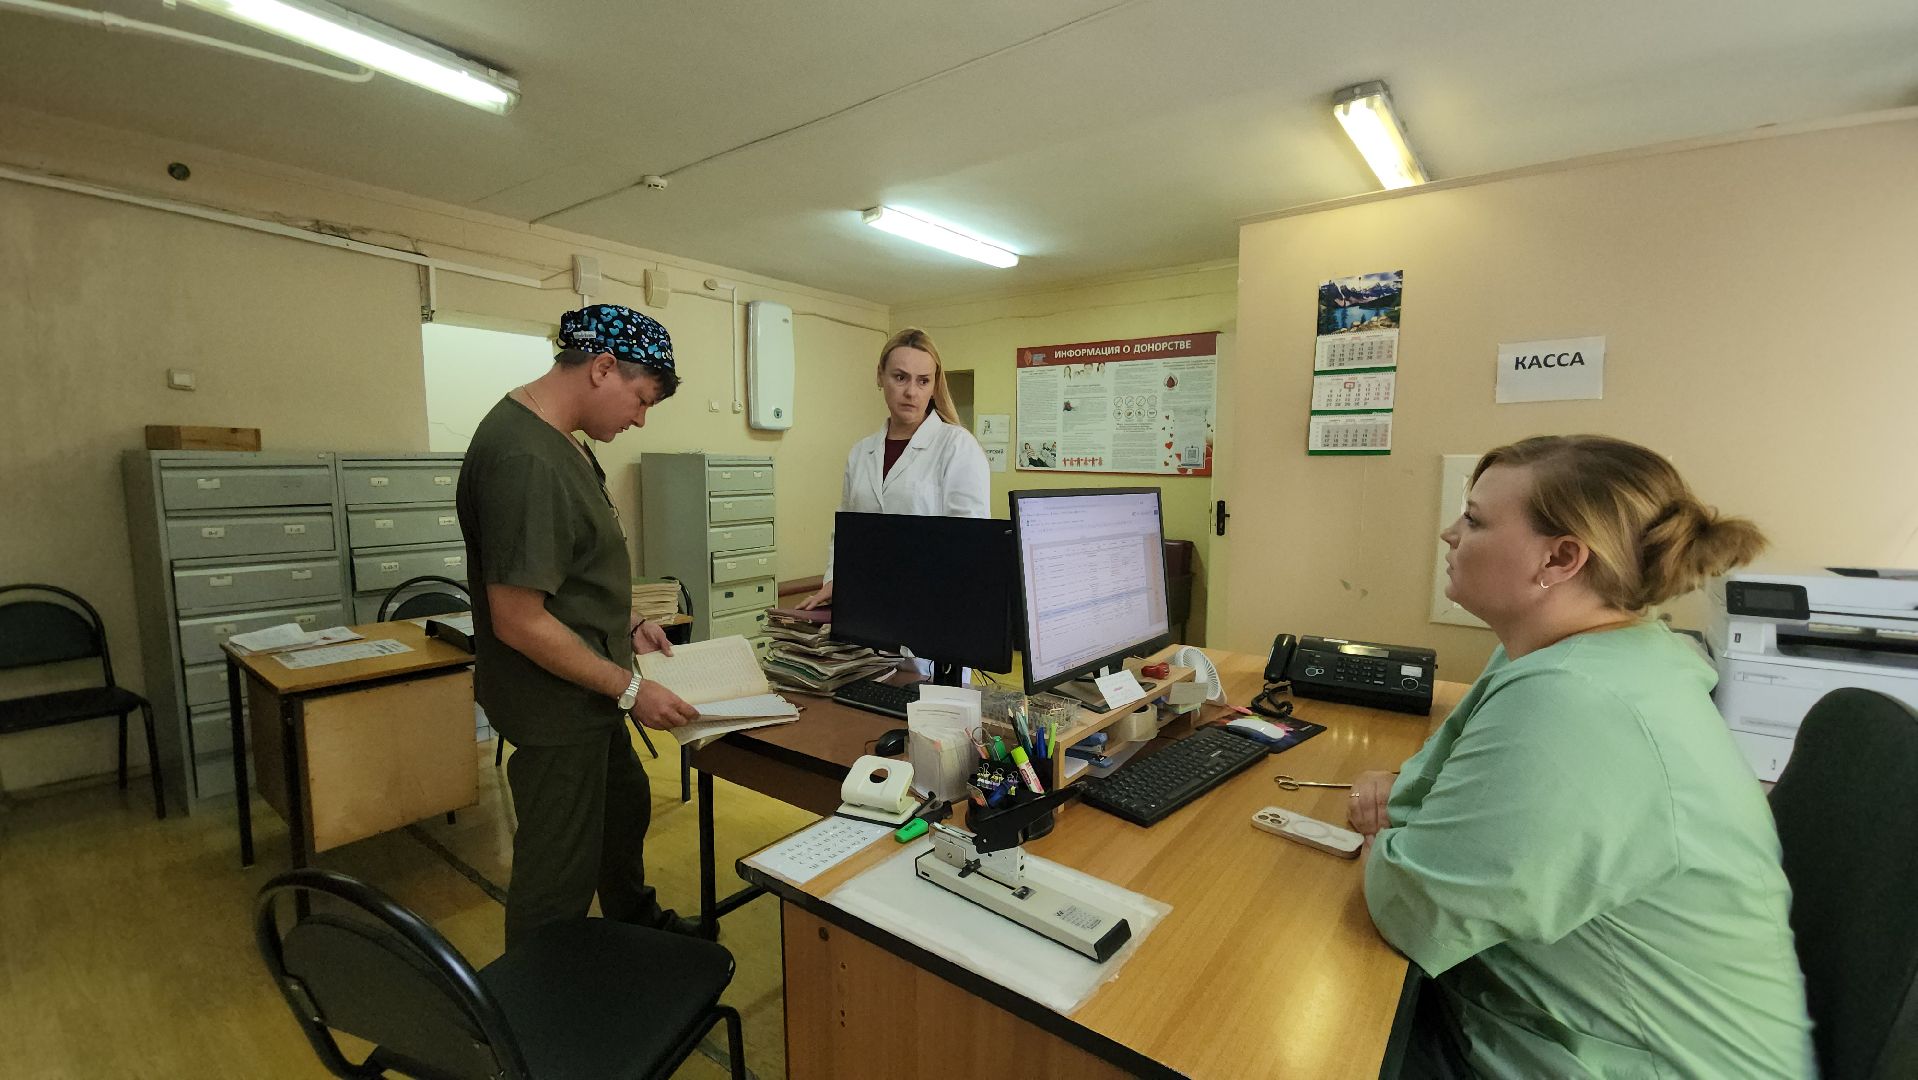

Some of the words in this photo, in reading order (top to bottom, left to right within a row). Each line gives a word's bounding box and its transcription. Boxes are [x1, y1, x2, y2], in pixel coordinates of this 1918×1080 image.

[1054, 345, 1120, 359] ИНФОРМАЦИЯ
[1122, 344, 1131, 354] О
[1133, 339, 1192, 355] ДОНОРСТВЕ
[1514, 351, 1585, 371] КАССА
